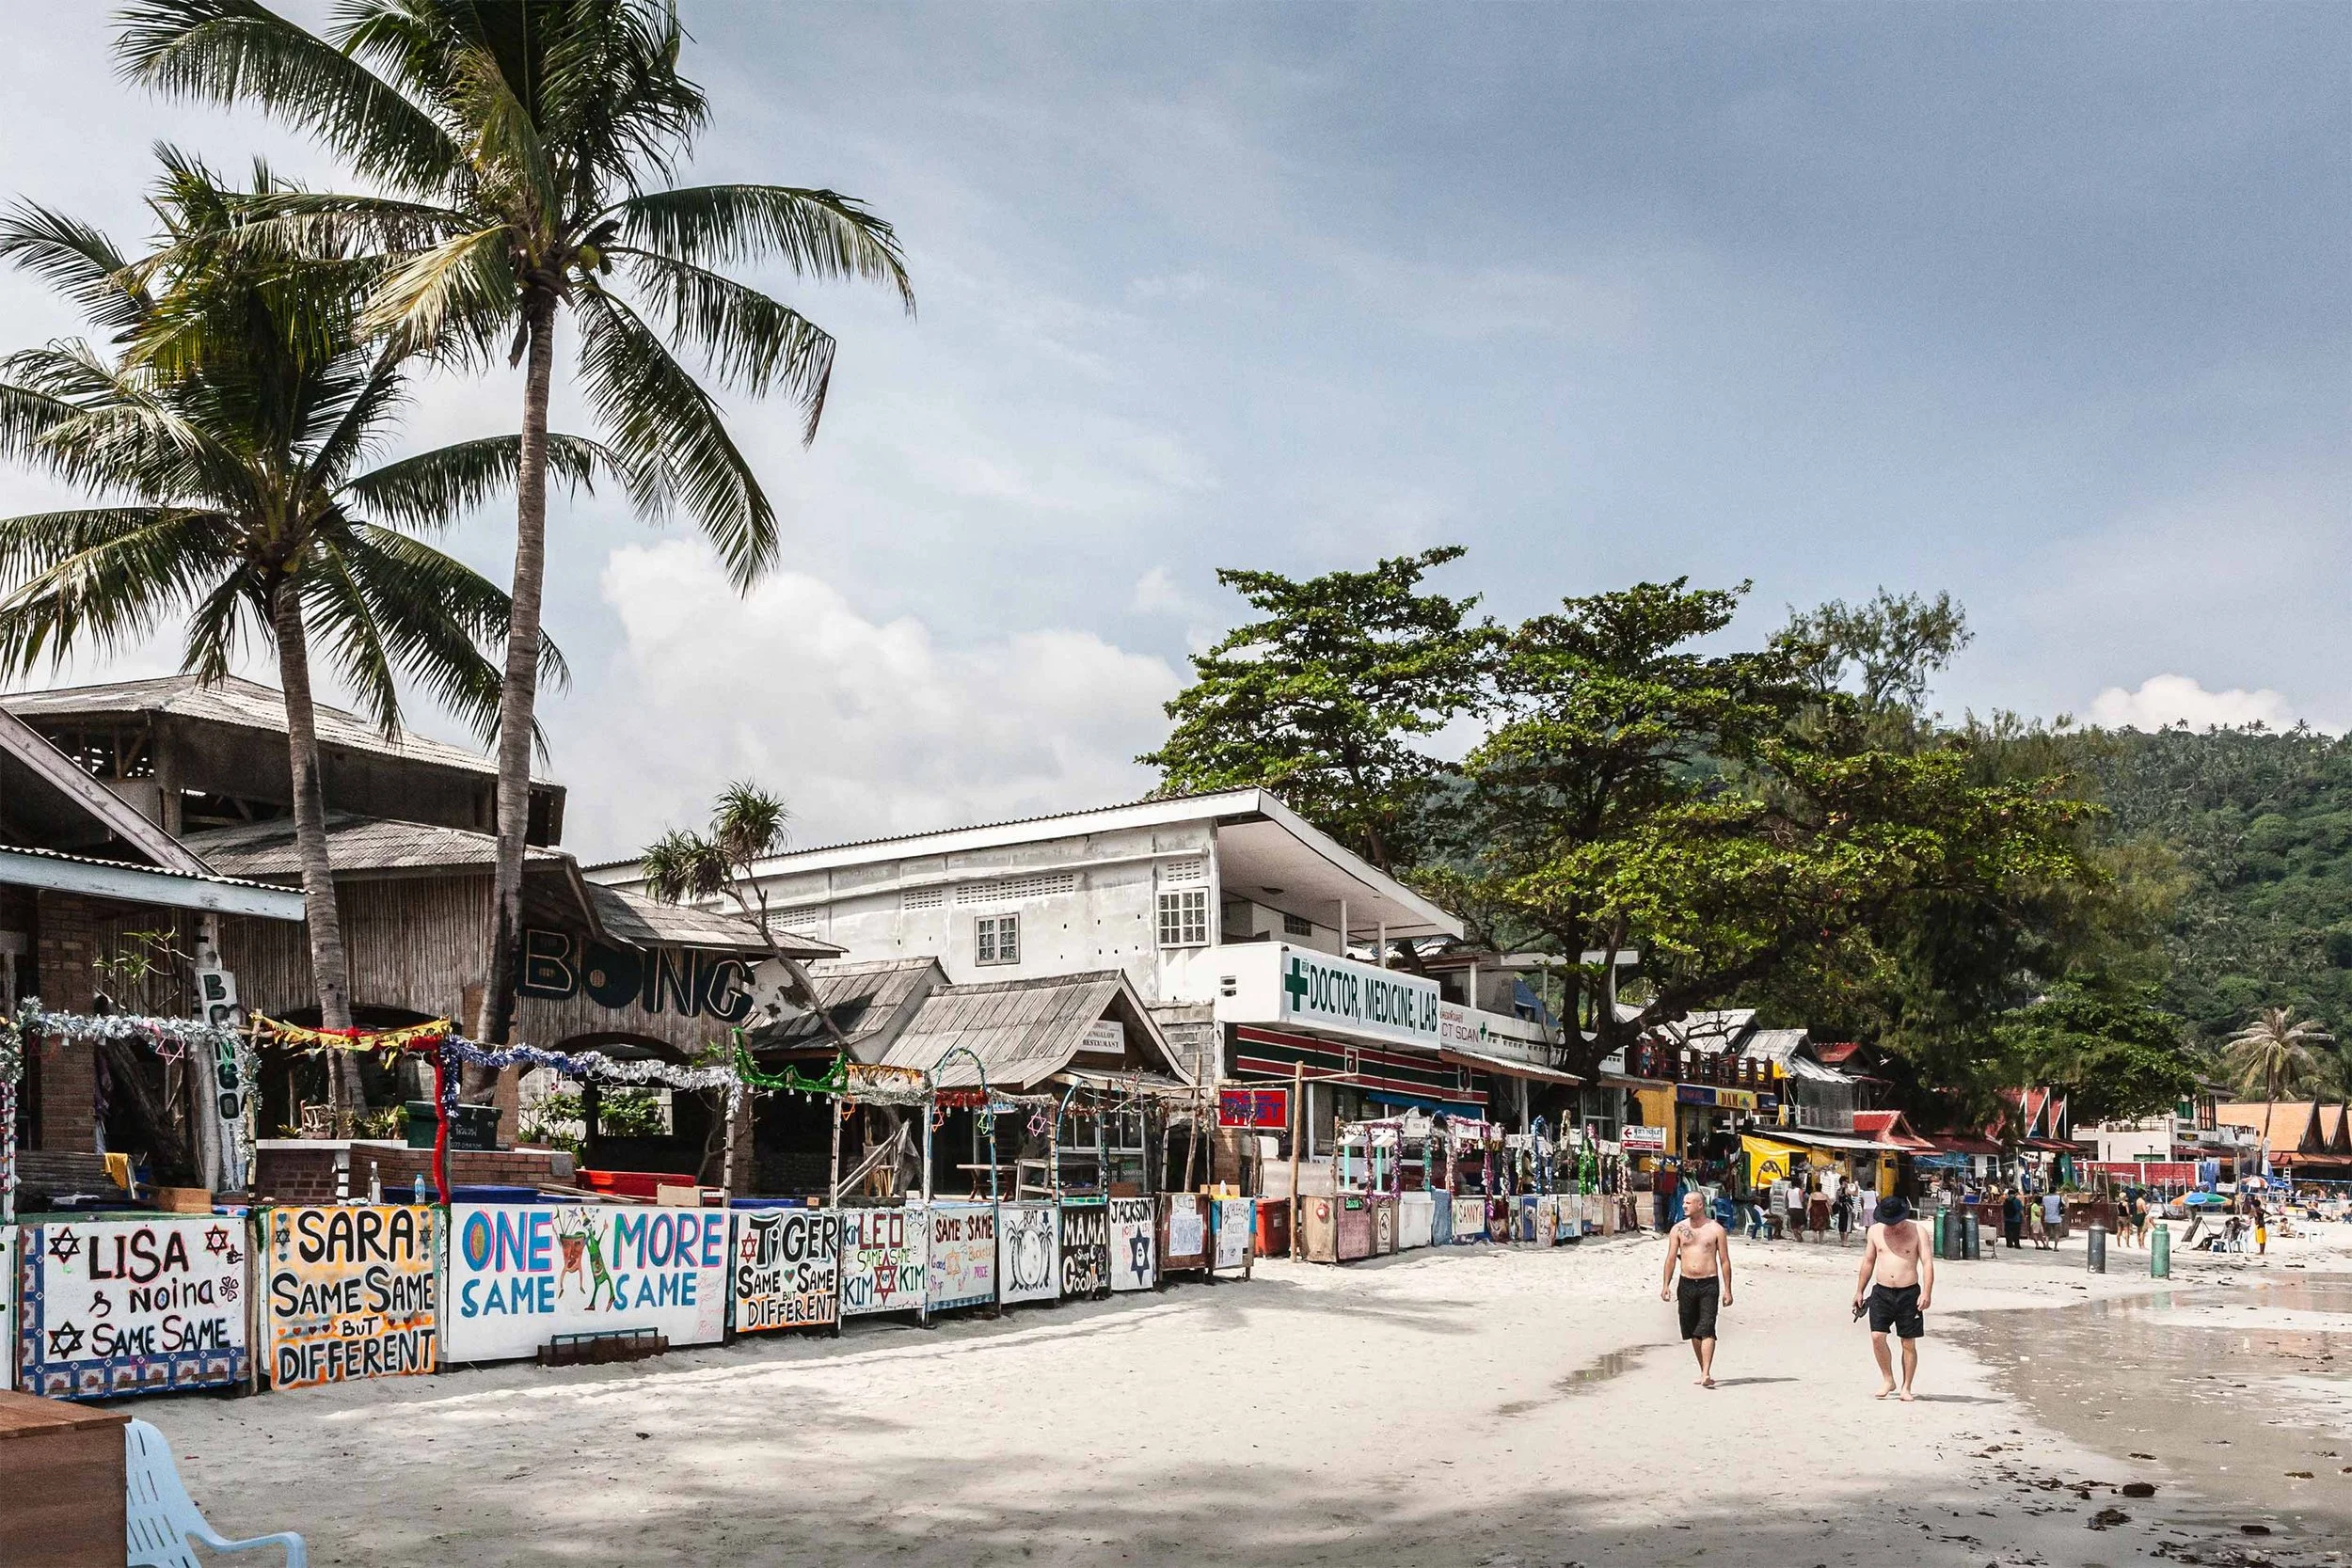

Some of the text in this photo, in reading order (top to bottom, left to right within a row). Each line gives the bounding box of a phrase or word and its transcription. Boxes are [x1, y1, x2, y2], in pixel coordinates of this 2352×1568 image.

[1311, 964, 1437, 1035] DOCTOR, MEDICINE, LAB
[1441, 1022, 1478, 1042] CT SCAN
[298, 1210, 414, 1263] SARA
[461, 1210, 554, 1274] ONE
[613, 1212, 723, 1271] MORE
[859, 1212, 903, 1249] LEO
[936, 1218, 961, 1243] SAME
[967, 1215, 993, 1241] SAME
[1063, 1213, 1106, 1246] MAMA
[88, 1229, 190, 1283] LISA
[857, 1249, 911, 1272] SAME SAME
[271, 1267, 435, 1318] SAME SAME
[461, 1275, 555, 1316] SAME
[613, 1273, 697, 1312] SAME
[738, 1263, 834, 1298] SAME SAME
[782, 1291, 797, 1302] BUT
[844, 1275, 873, 1306] KIM
[899, 1264, 926, 1291] KIM
[747, 1292, 837, 1327] DIFFERENT
[92, 1315, 230, 1357] SAME SAME
[278, 1328, 436, 1386] DIFFERENT
